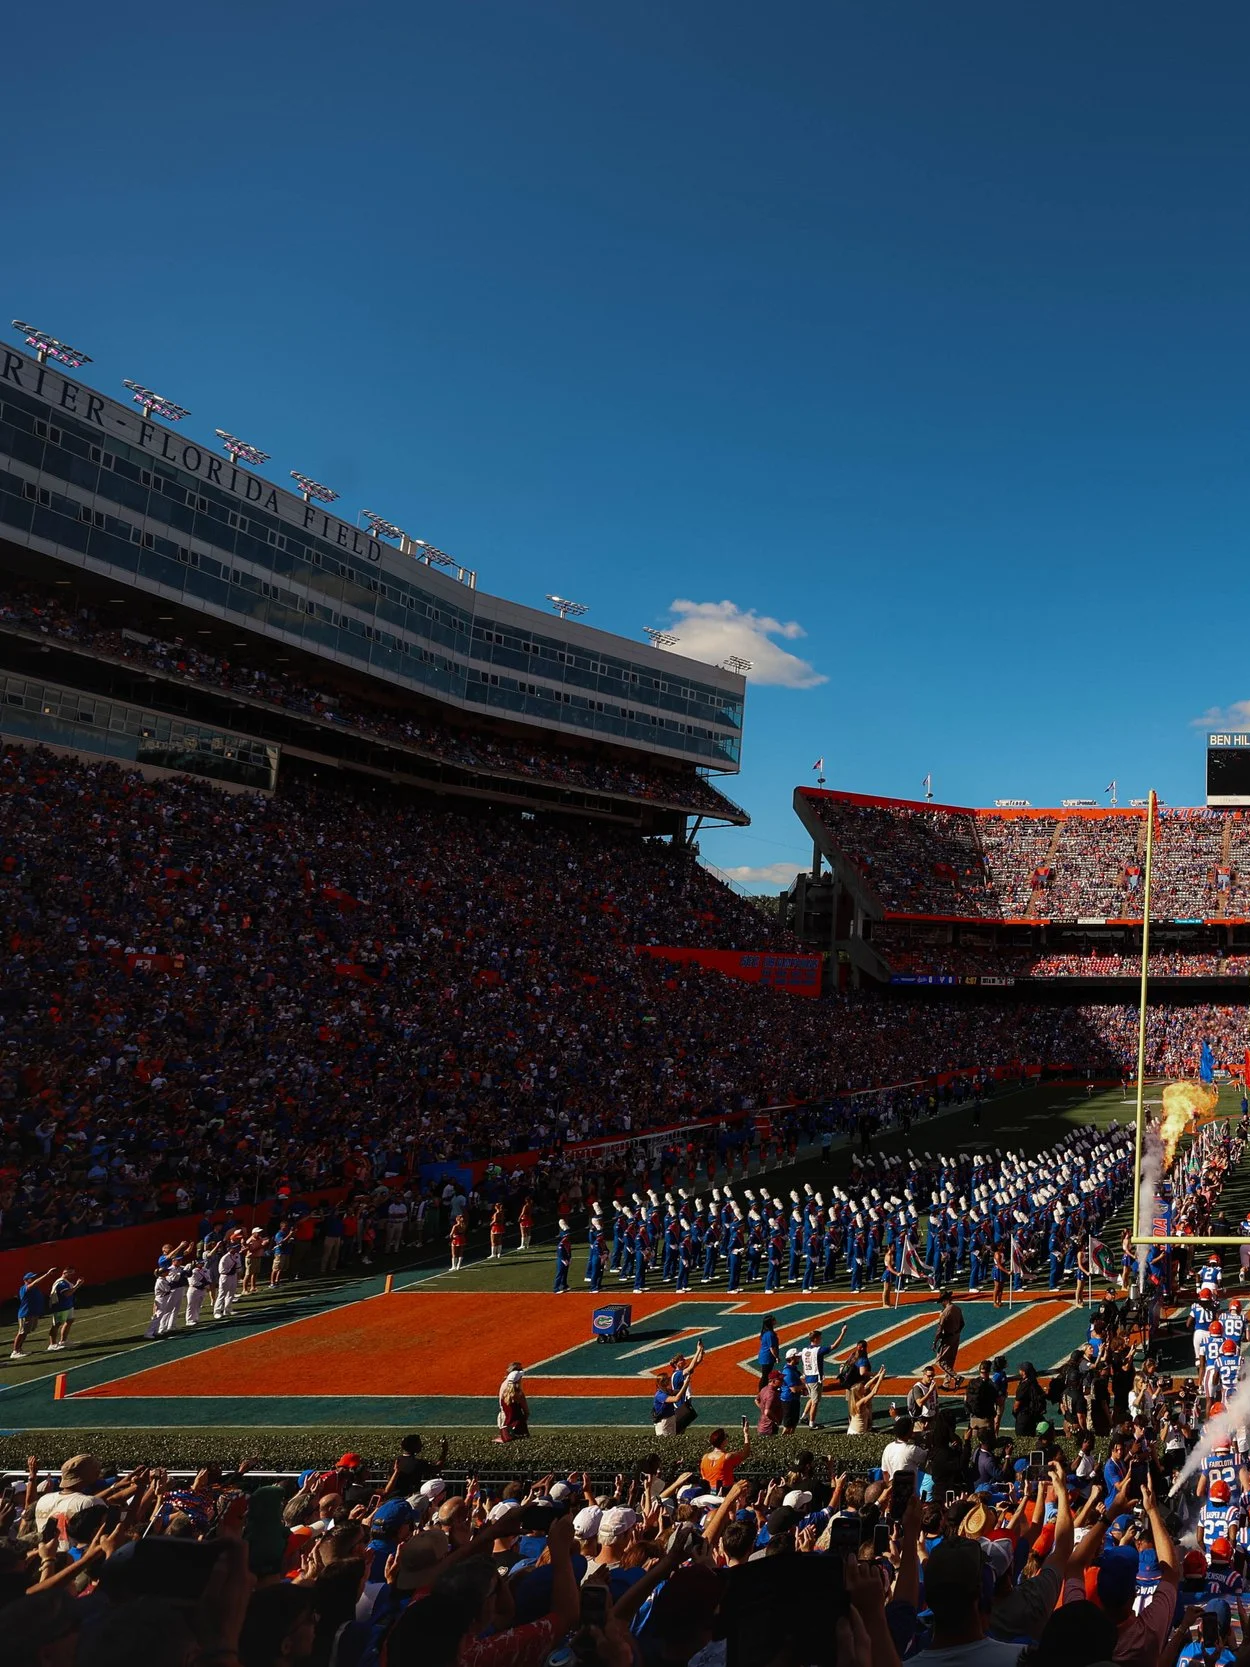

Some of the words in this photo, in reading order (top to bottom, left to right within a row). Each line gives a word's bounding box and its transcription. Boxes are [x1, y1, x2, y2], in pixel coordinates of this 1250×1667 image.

[302, 508, 382, 562] FIELD
[1210, 735, 1231, 745] BEN
[1208, 1267, 1214, 1280] 2
[1225, 1319, 1243, 1336] 89
[1209, 1459, 1233, 1467] FAIRCLOTH
[1203, 1520, 1228, 1545] 23
